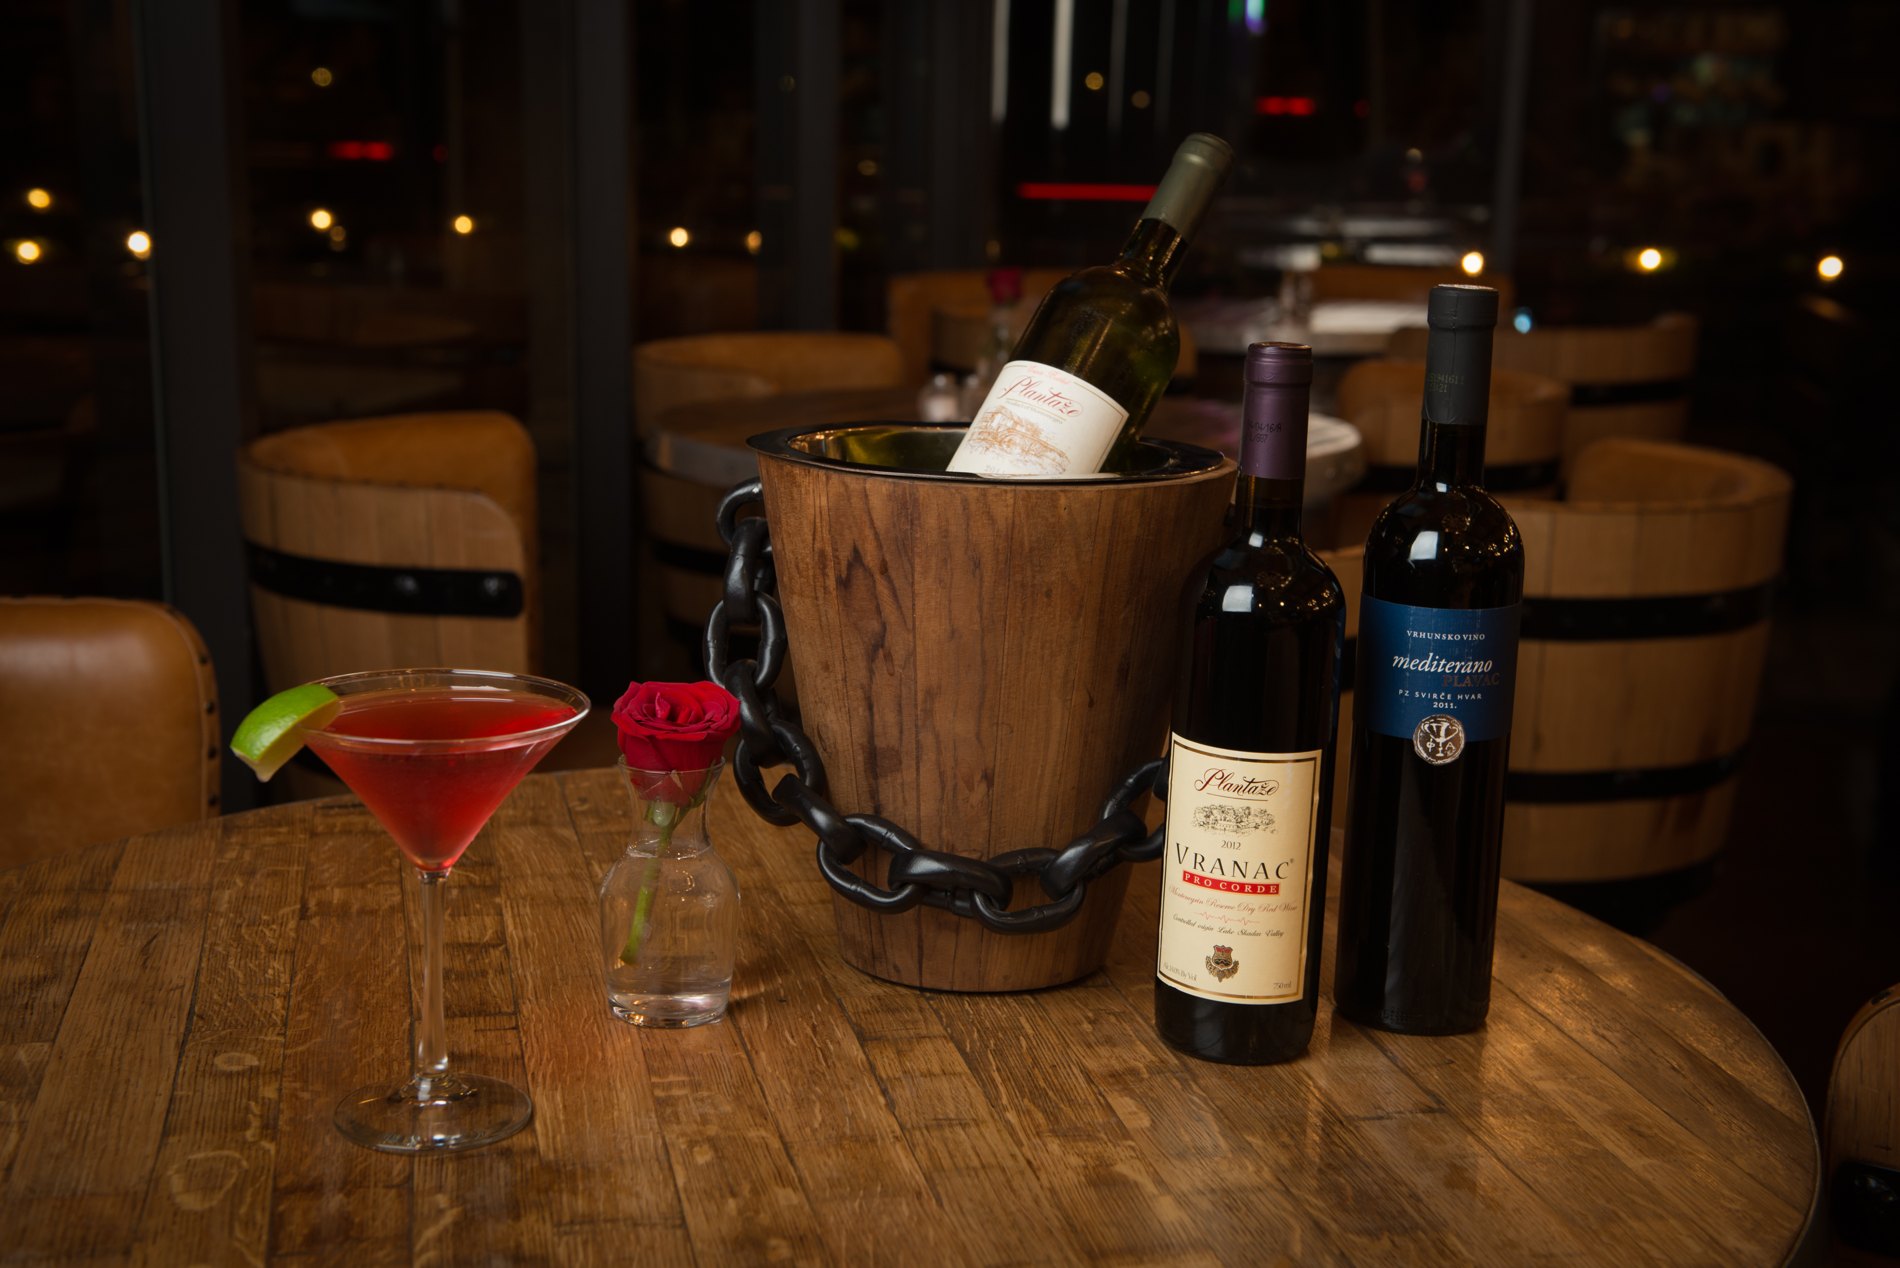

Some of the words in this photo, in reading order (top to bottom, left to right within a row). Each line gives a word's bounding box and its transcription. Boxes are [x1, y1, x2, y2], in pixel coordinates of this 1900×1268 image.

[1406, 630, 1460, 641] VRHUNSKO
[1462, 633, 1486, 641] VINO
[1392, 653, 1493, 674] mediterano
[1442, 673, 1500, 687] PLAVAC
[1398, 689, 1410, 697] PZ
[1414, 691, 1452, 700] SVIRČE
[1194, 768, 1280, 796] Plantaže
[1220, 840, 1241, 850] 2012
[1184, 872, 1212, 887] PRO
[1219, 882, 1278, 894] CORDE
